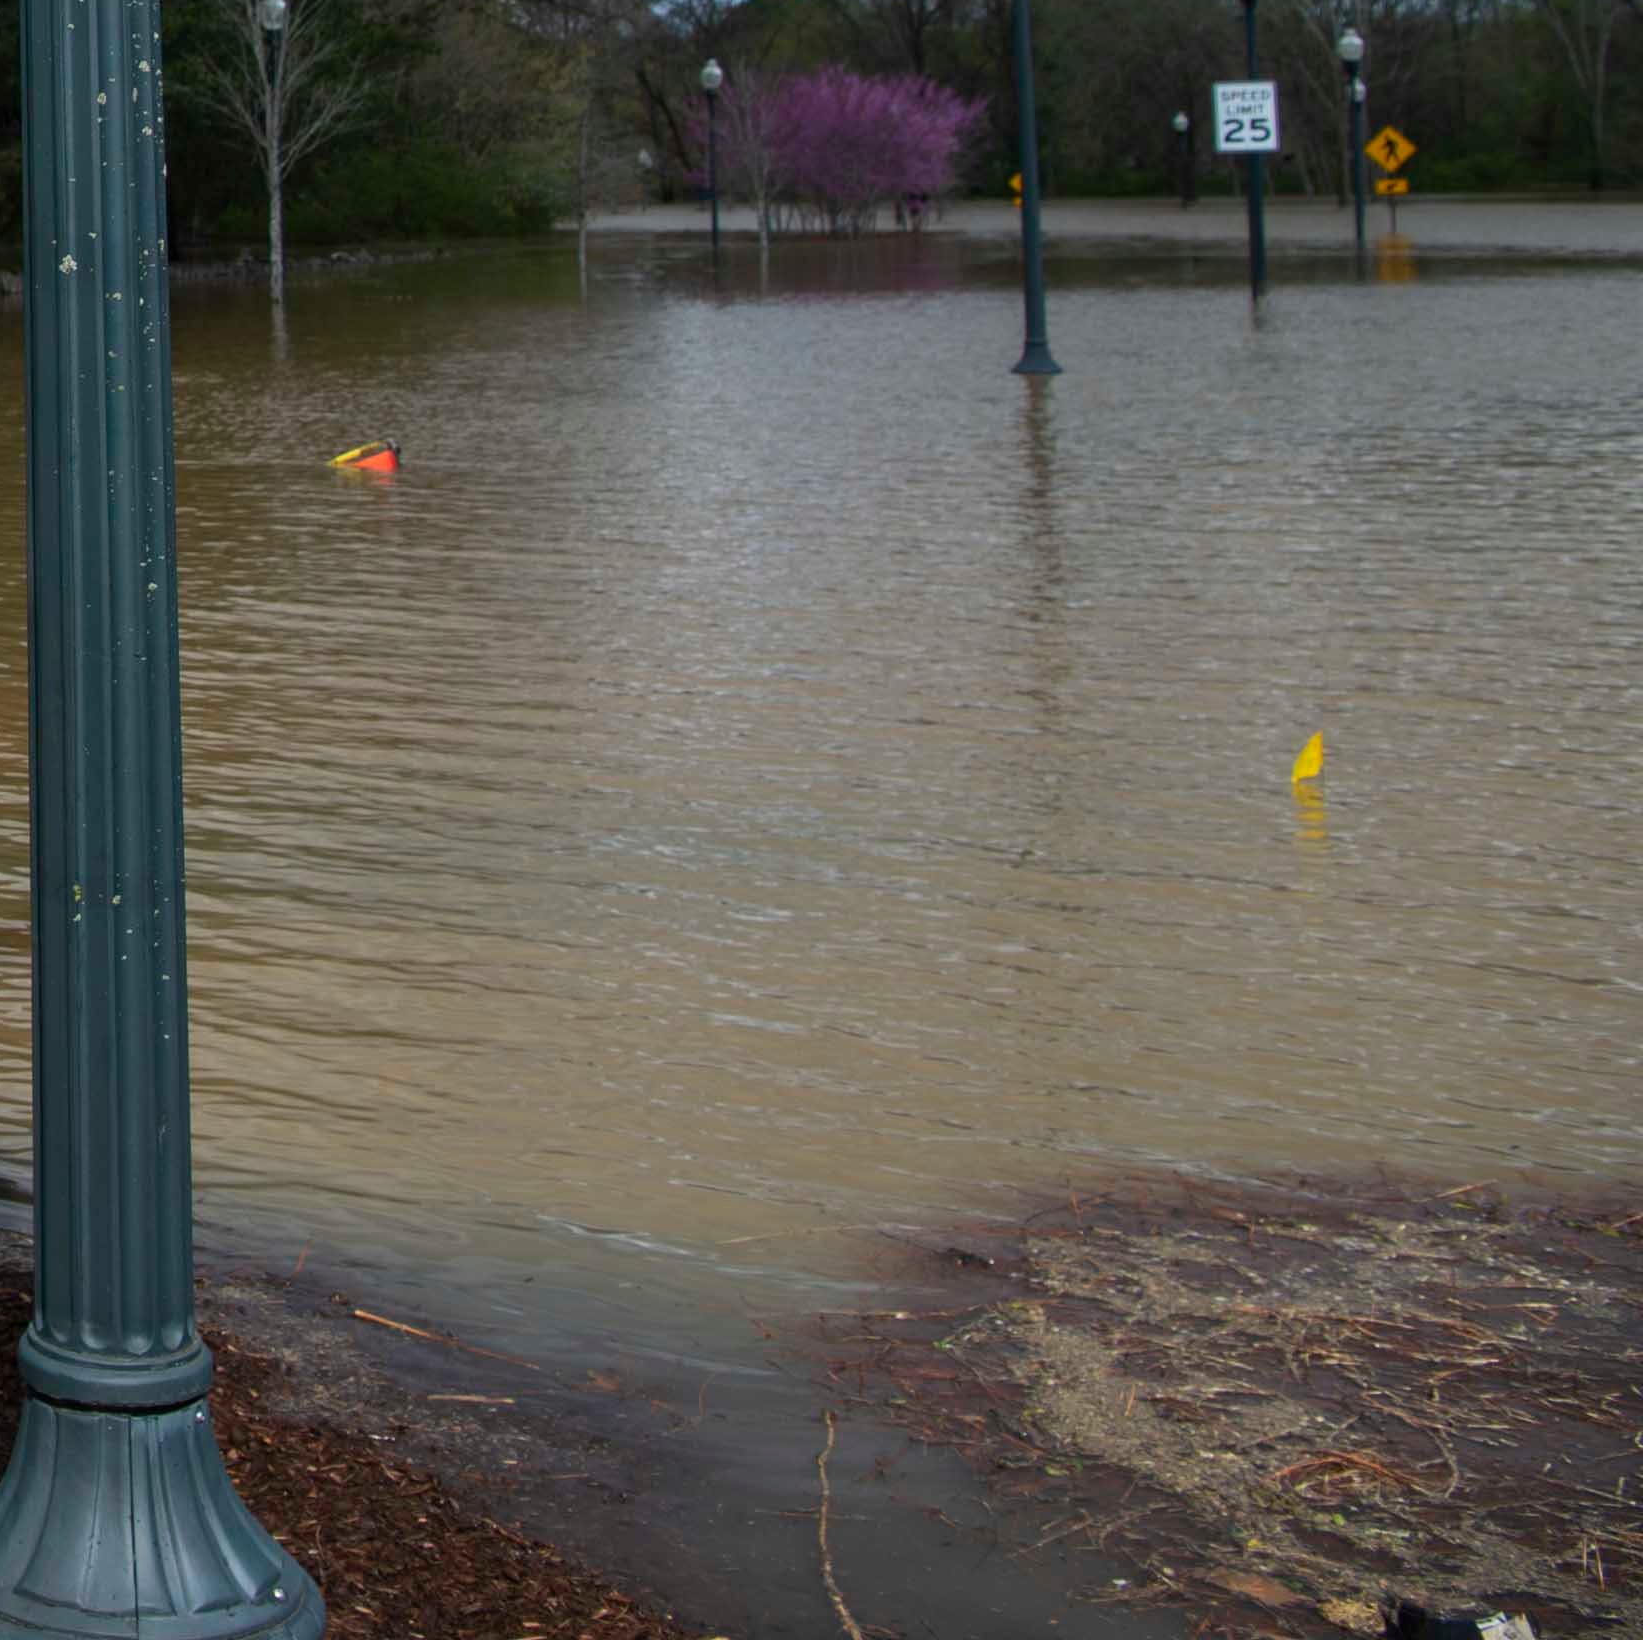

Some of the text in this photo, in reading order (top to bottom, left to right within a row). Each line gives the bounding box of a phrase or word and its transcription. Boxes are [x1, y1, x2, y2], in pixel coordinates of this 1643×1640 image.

[1221, 89, 1270, 100] SPEED
[1226, 103, 1264, 115] LIMIT
[1223, 118, 1271, 143] 25
